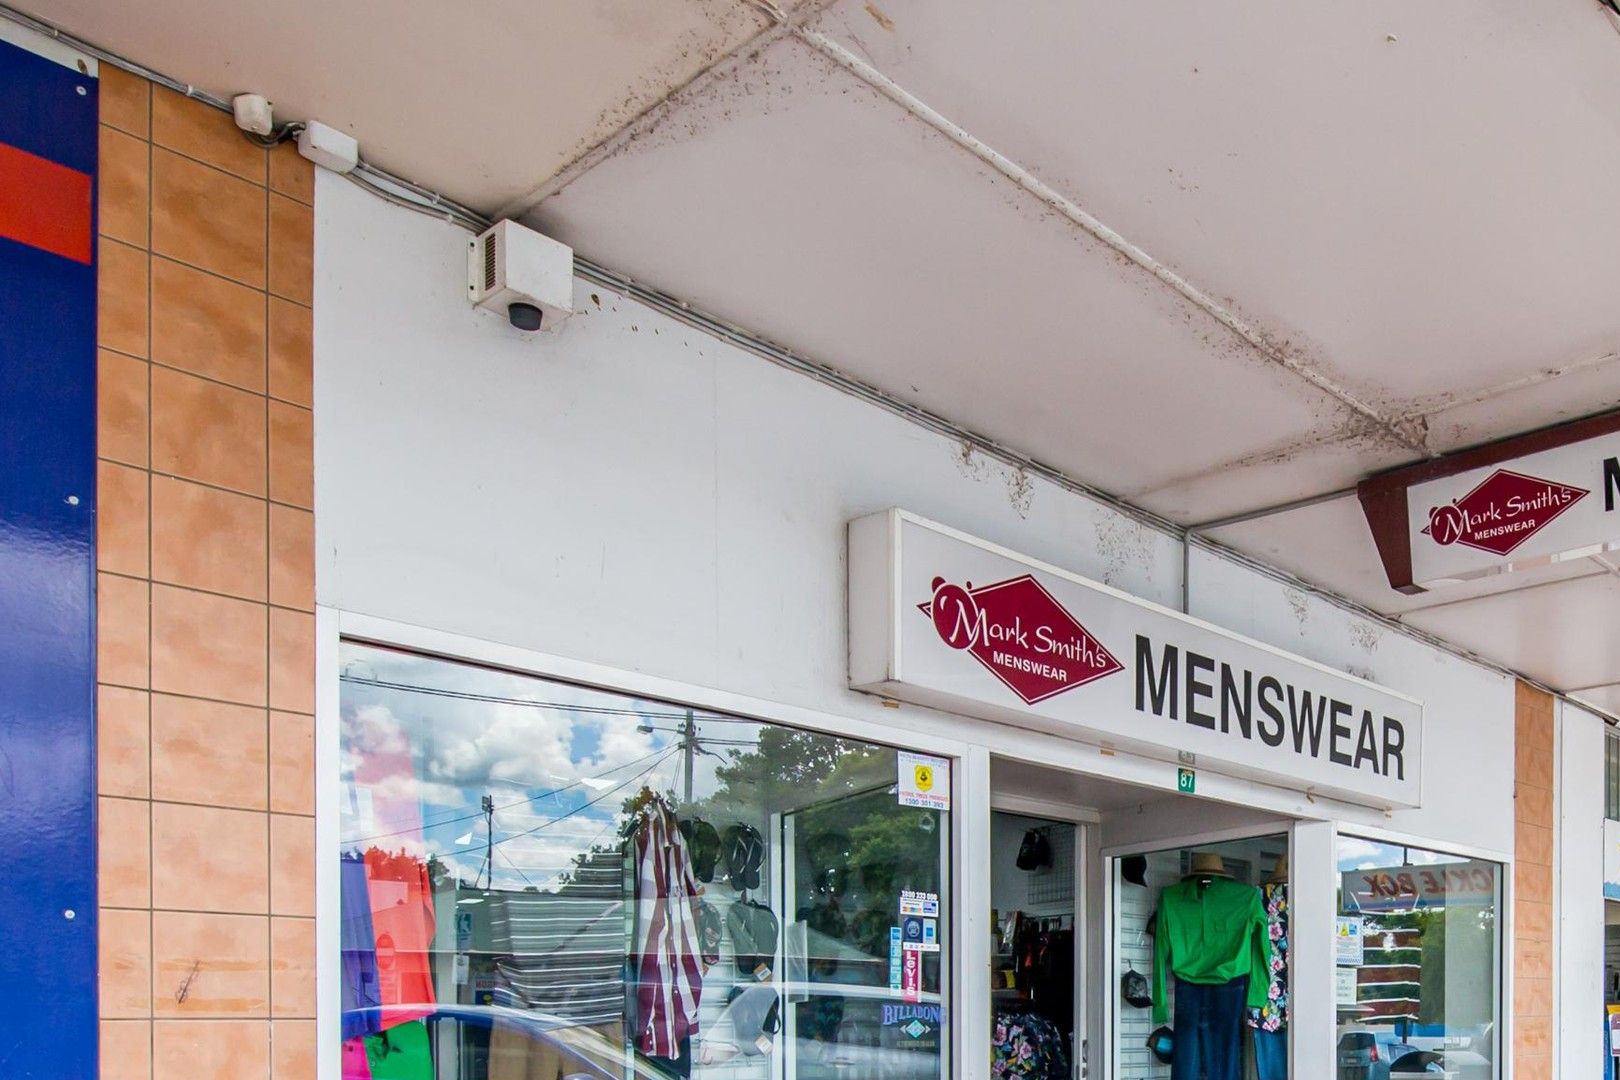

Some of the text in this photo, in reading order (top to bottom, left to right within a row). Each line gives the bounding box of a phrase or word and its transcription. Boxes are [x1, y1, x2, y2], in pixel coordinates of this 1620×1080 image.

[1435, 486, 1573, 545] Mark Smith's
[1474, 519, 1536, 541] MENSWEAR
[940, 593, 1107, 669] Mark Smith's
[992, 650, 1068, 682] MENSWEAR
[1134, 634, 1406, 781] MENSWEAR
[1181, 774, 1194, 789] 87
[883, 1004, 946, 1025] BILLABONG
